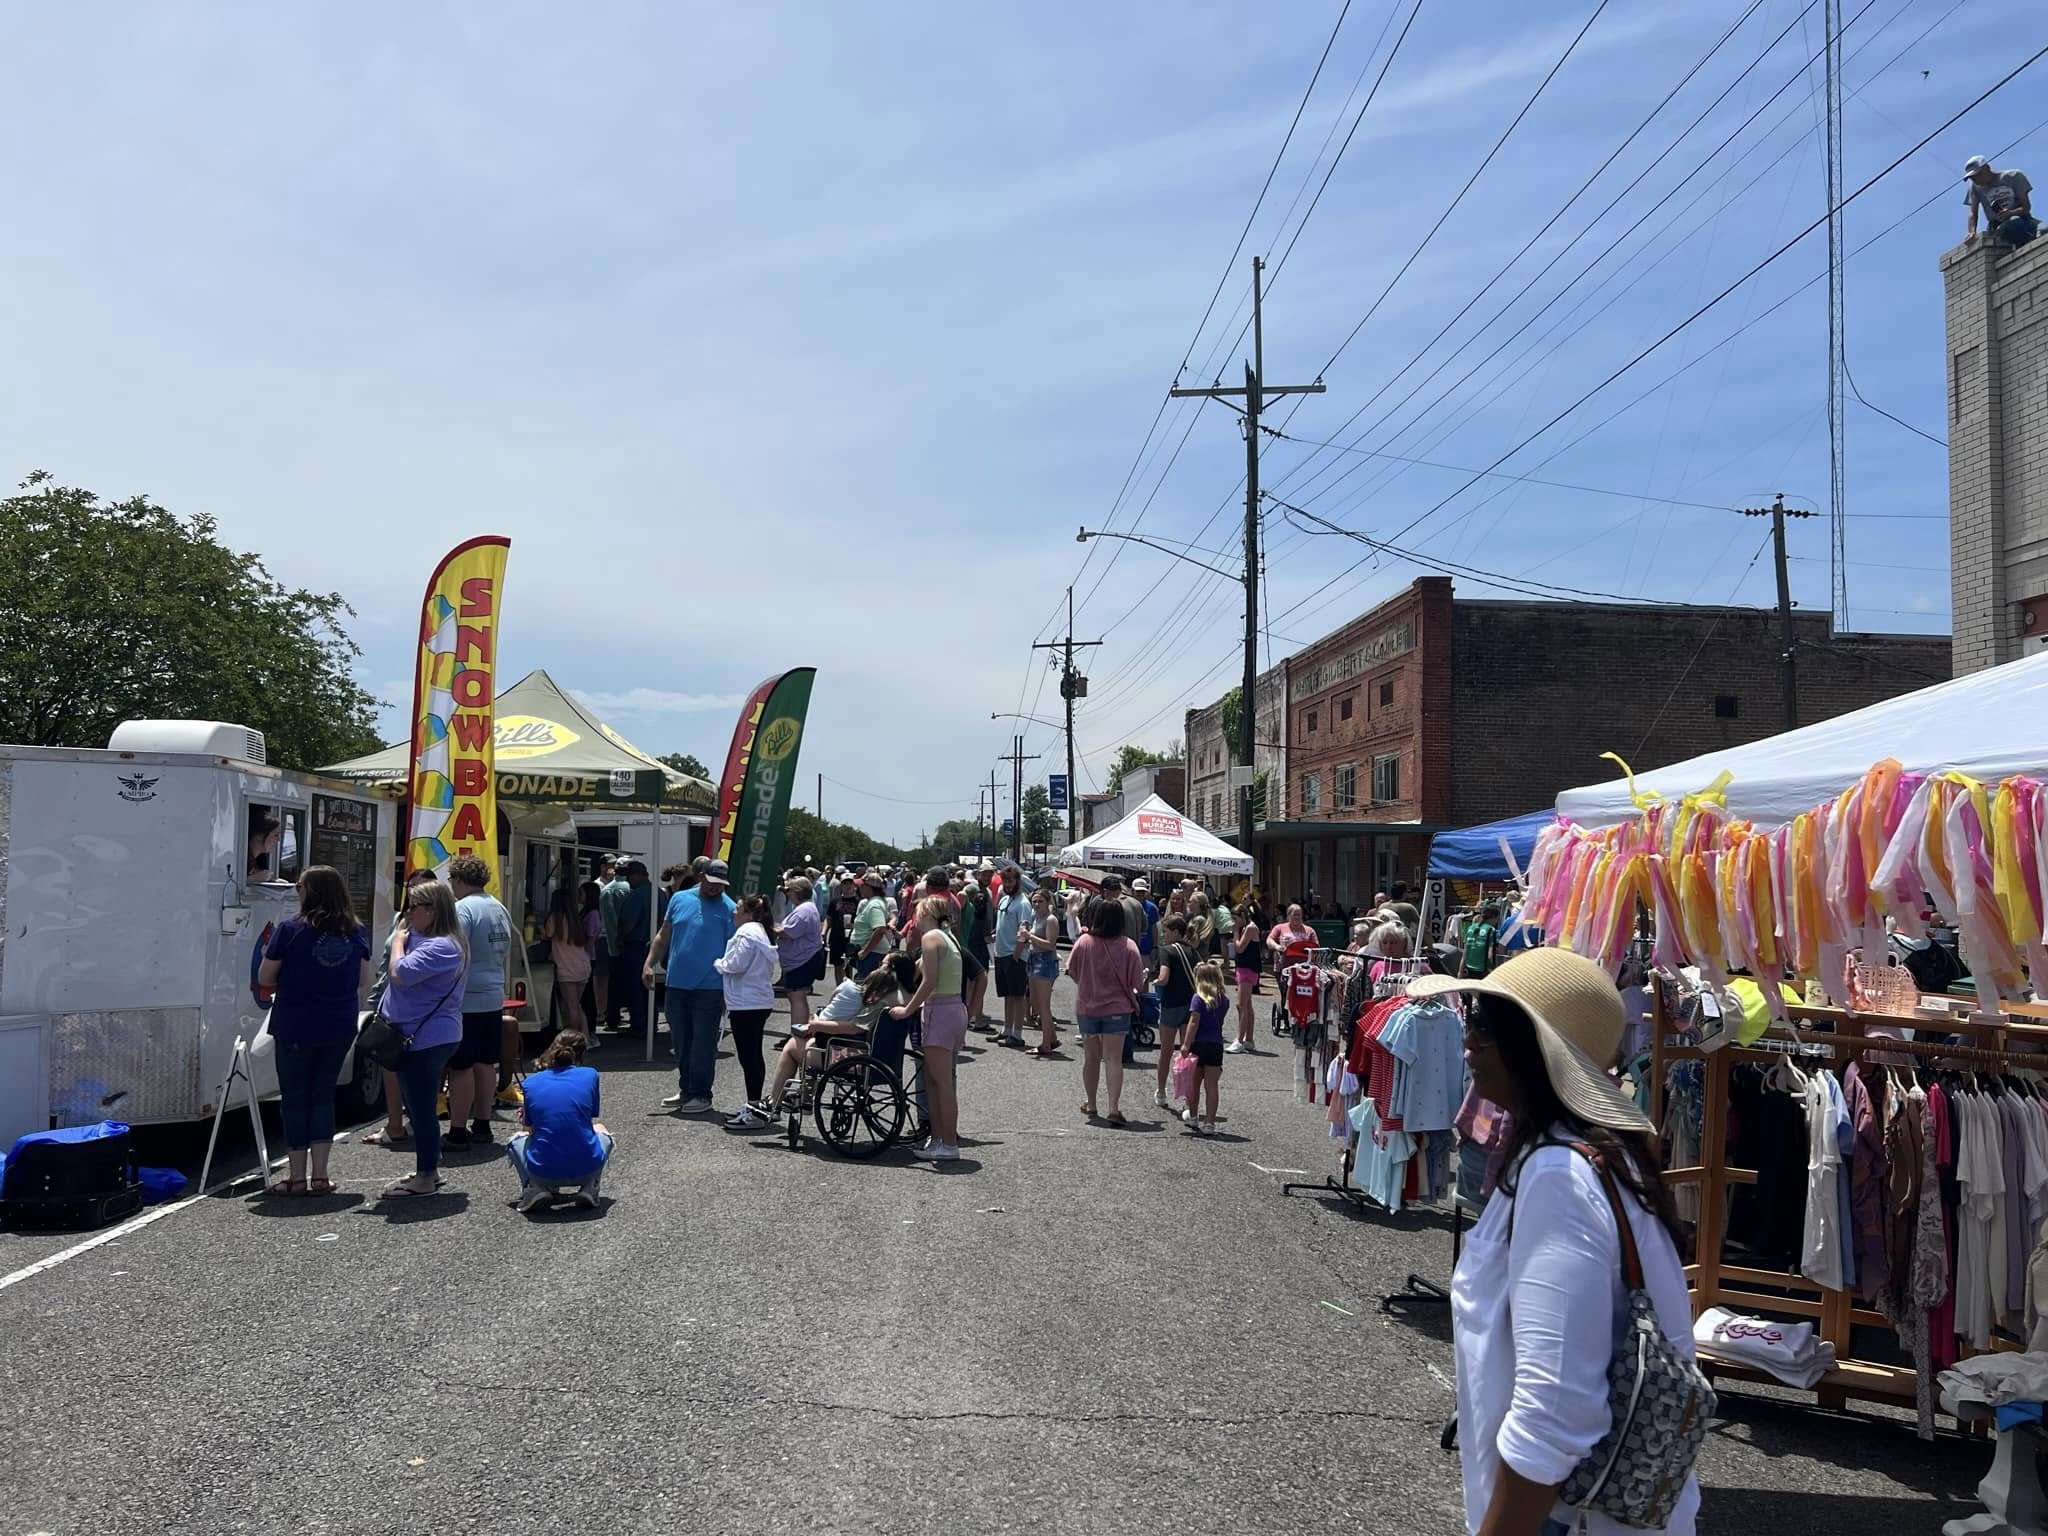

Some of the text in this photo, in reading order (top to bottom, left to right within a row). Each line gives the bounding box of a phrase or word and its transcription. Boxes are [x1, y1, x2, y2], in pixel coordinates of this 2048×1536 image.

[451, 578, 493, 854] SNOWBA
[343, 769, 404, 777] LOW SUGAR
[614, 770, 631, 781] 140
[496, 774, 600, 796] ONADE
[743, 767, 778, 897] emonade
[1142, 822, 1177, 830] BUREAU
[1180, 854, 1201, 863] Real
[1431, 882, 1442, 943] OTARY
